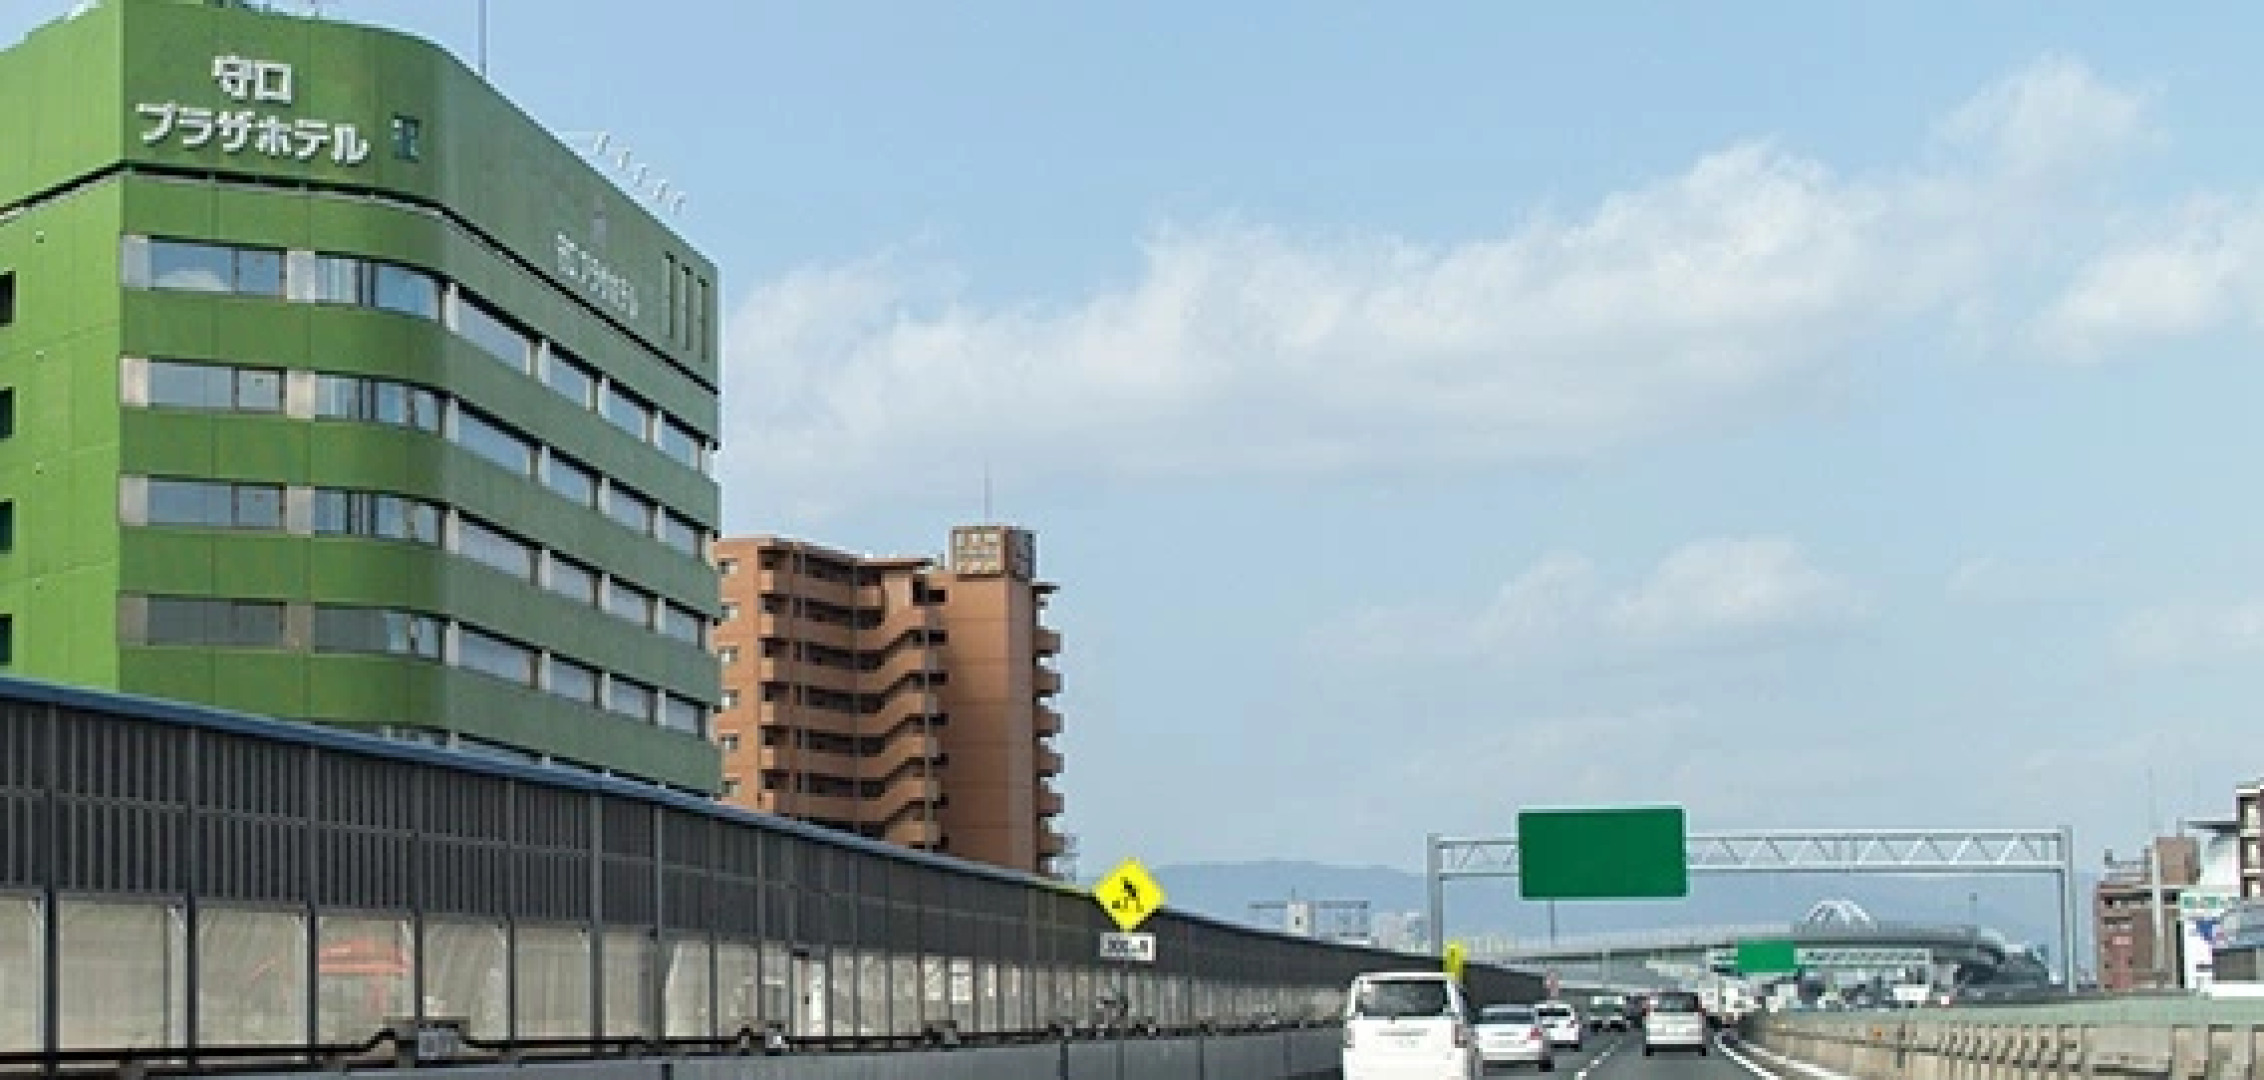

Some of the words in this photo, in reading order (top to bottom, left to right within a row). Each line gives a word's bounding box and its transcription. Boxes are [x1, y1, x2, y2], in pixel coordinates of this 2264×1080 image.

[211, 55, 292, 101] 守口
[135, 101, 369, 164] プラザホテル
